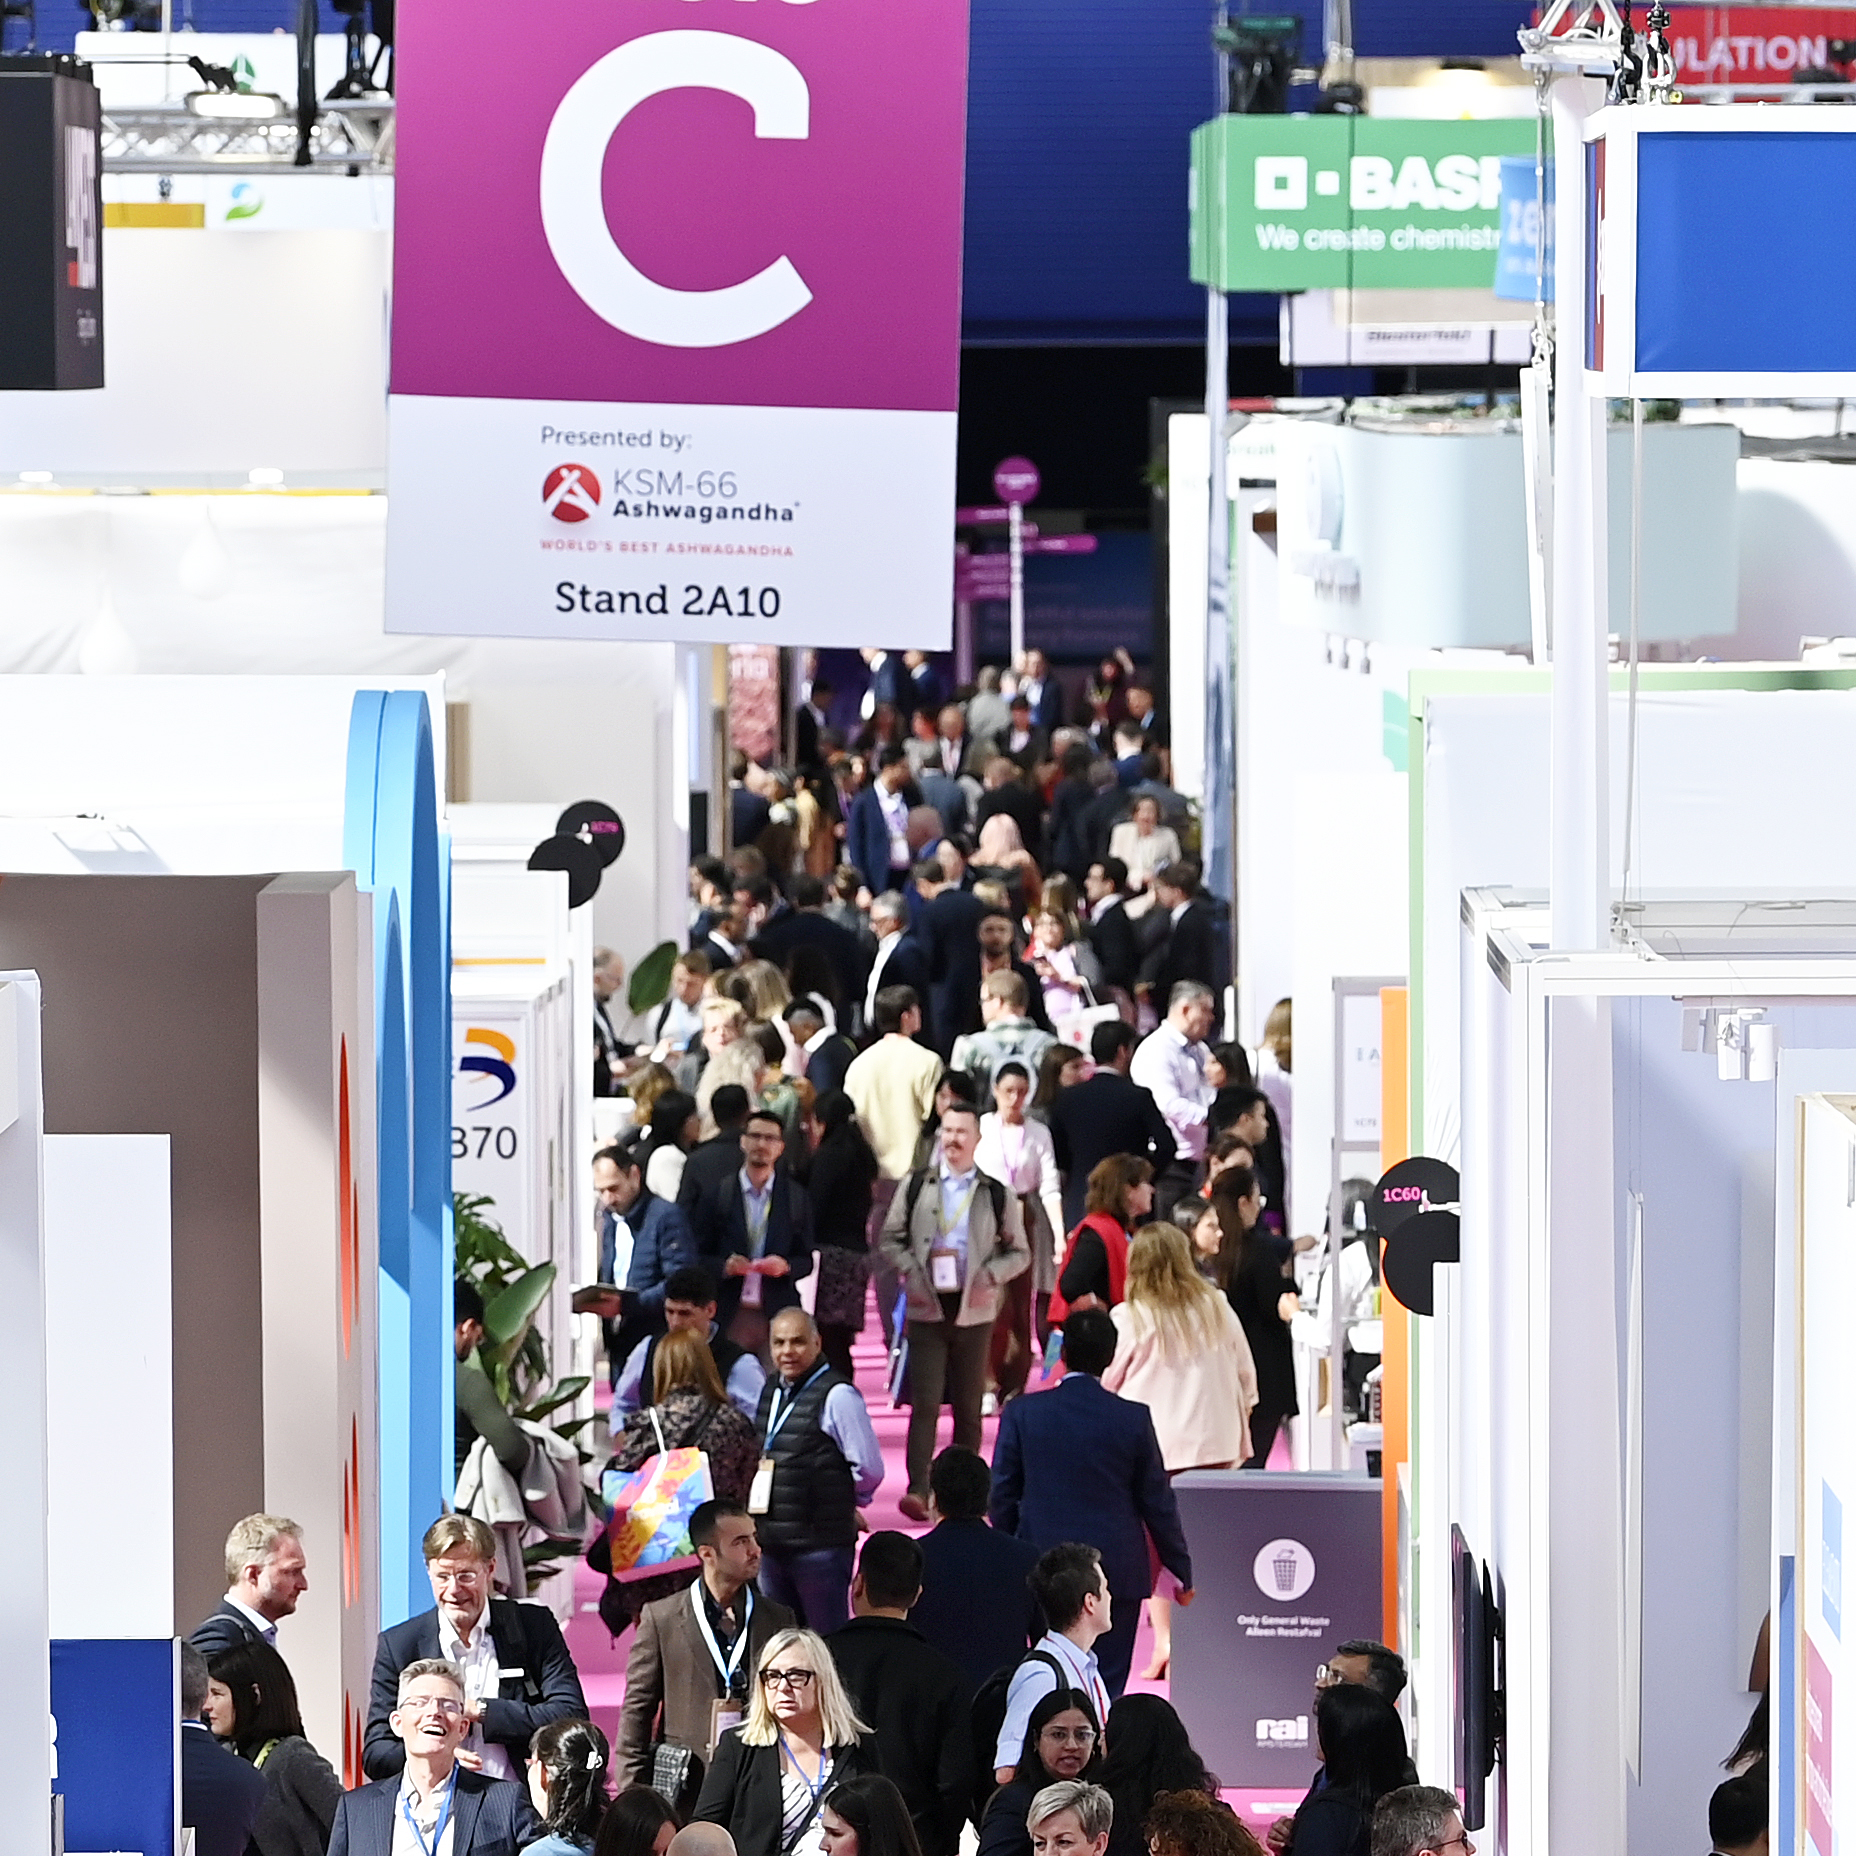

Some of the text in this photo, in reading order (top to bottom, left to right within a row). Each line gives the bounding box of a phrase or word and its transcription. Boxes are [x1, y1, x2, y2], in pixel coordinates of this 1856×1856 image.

[1671, 36, 1827, 71] LATION
[540, 30, 812, 347] C
[1255, 223, 1501, 250] We create chemistr
[542, 426, 693, 452] Presented by:
[614, 469, 737, 498] KSM-66
[557, 582, 780, 618] Stand 2A10
[1382, 1186, 1422, 1203] 1C60
[1255, 1715, 1309, 1740] rai
